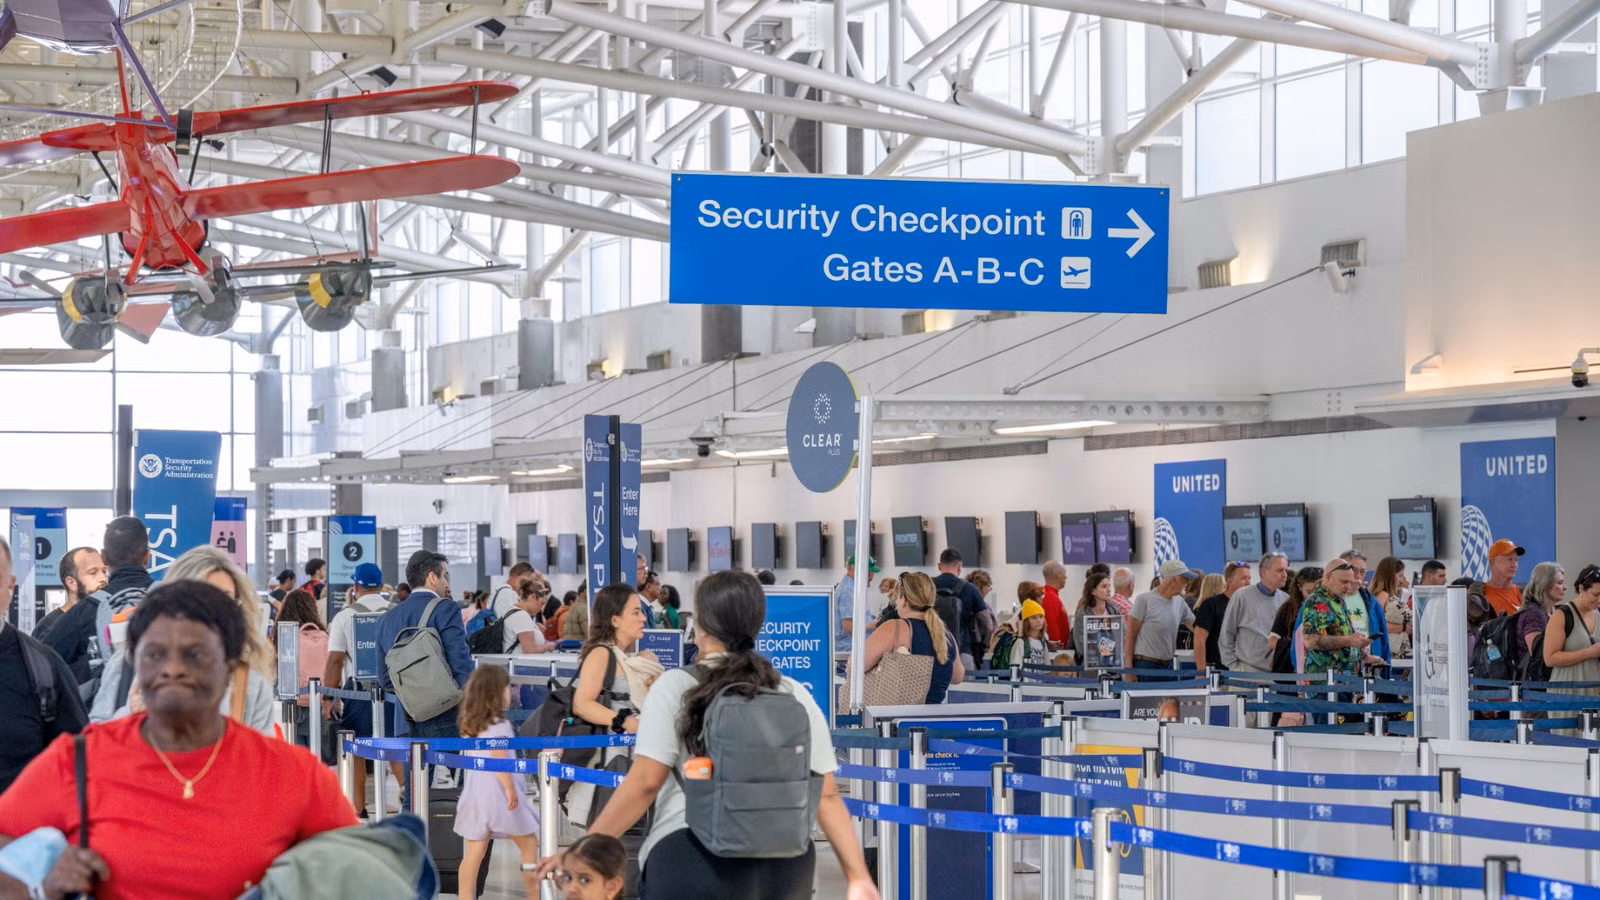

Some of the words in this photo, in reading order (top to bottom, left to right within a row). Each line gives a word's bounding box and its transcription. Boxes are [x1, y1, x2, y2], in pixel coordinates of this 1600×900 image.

[698, 200, 839, 237] Security
[851, 203, 1046, 240] Checkpoint
[823, 254, 923, 282] Gates
[933, 256, 1044, 285] A-B-C
[803, 433, 841, 448] CLEAR
[165, 457, 213, 466] Transportation
[1486, 454, 1548, 477] UNITED
[165, 471, 214, 479] Administration
[1172, 474, 1220, 493] UNITED
[622, 486, 639, 500] Enter
[622, 503, 638, 516] Here
[592, 482, 605, 552] TSA
[144, 504, 178, 574] TSA
[37, 543, 42, 555] 1
[349, 546, 358, 558] 2
[759, 622, 811, 635] ECURITY
[1087, 622, 1110, 630] REAL
[1111, 622, 1120, 630] ID
[357, 641, 376, 649] Enter
[771, 656, 811, 669] GATES
[1134, 708, 1146, 717] ARE
